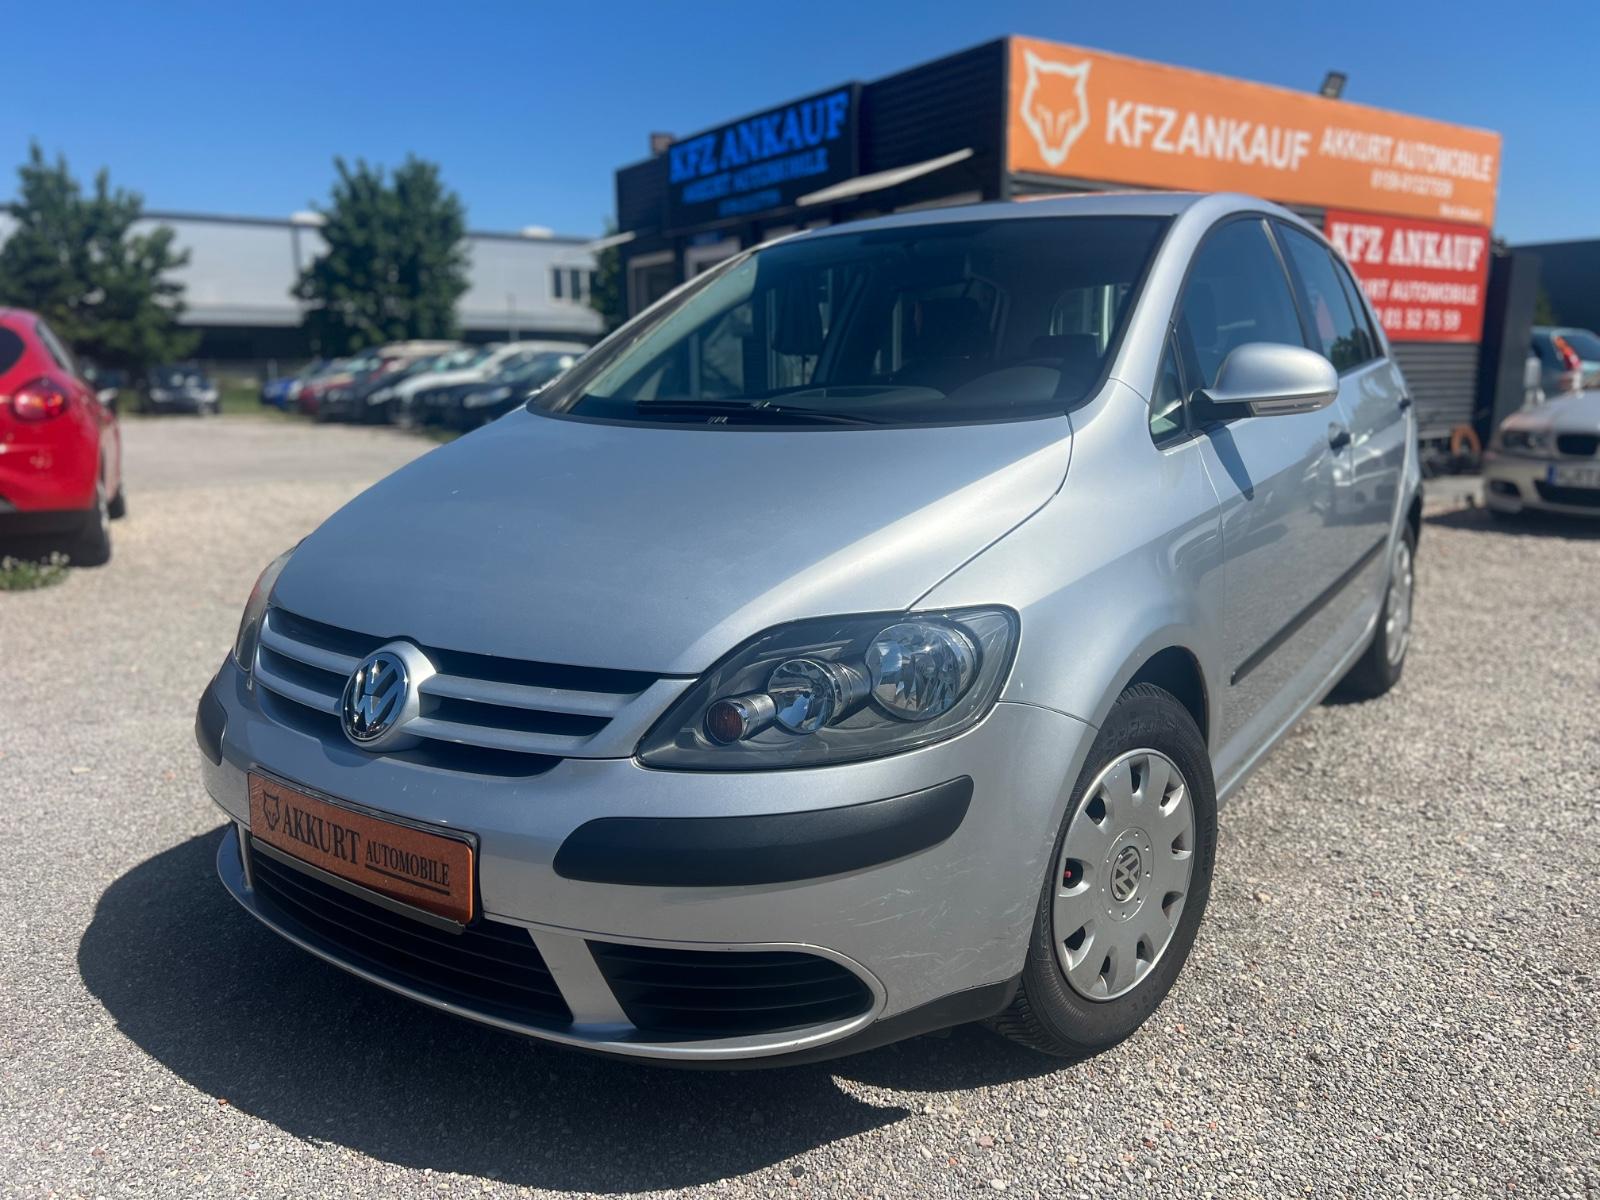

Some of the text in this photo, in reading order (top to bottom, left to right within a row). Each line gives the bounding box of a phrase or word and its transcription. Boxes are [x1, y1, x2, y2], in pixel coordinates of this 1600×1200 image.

[669, 91, 849, 185] KFZ ANKAUF
[1105, 99, 1312, 171] KFZANKAUF
[1319, 126, 1493, 182] AKKURT AUTOMOBILE
[1330, 222, 1484, 272] KFZ ANKAUF
[1390, 280, 1479, 306] AUTOMOBILE
[282, 804, 450, 887] AKKURT AUTOMOBILE
